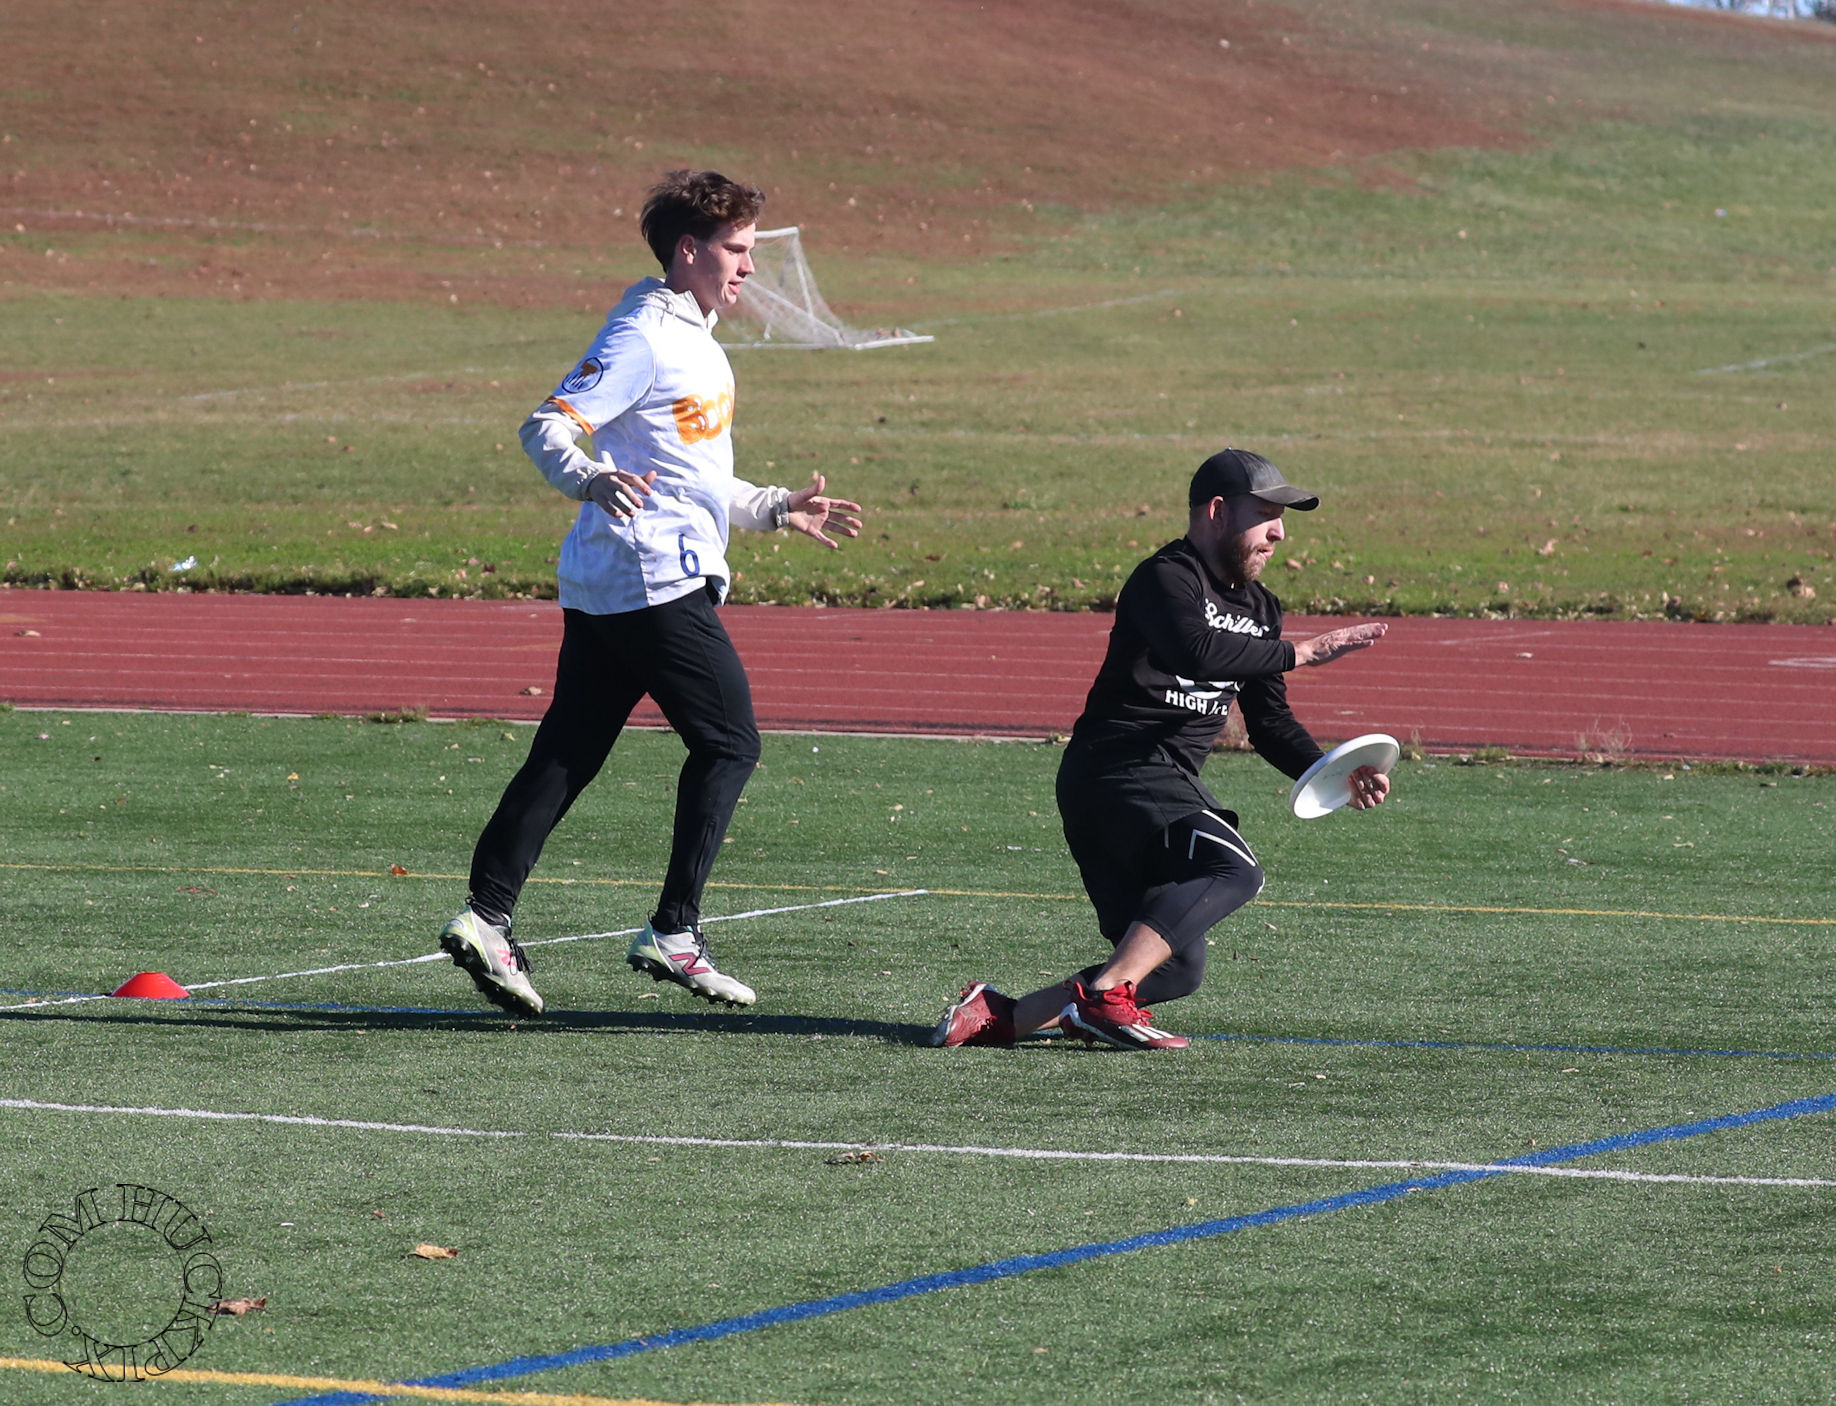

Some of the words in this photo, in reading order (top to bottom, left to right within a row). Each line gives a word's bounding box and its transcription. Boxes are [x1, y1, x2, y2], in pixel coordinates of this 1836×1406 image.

[678, 533, 700, 577] 6
[1204, 598, 1270, 638] Schiller
[1164, 689, 1208, 716] HIGH
